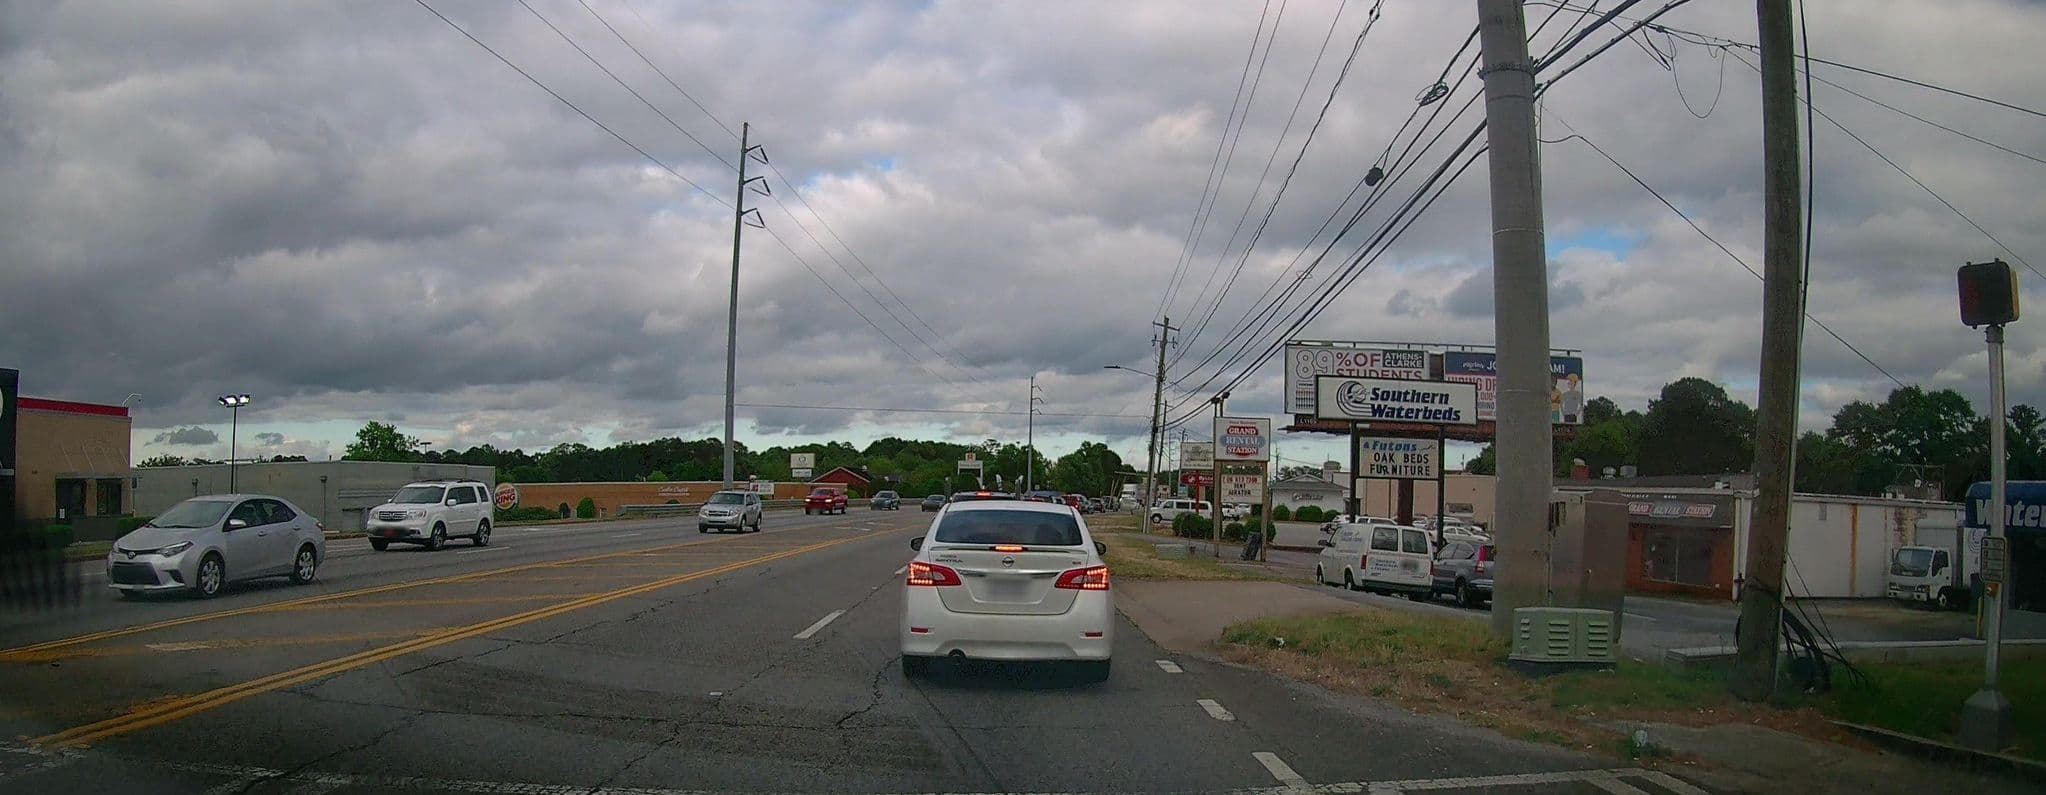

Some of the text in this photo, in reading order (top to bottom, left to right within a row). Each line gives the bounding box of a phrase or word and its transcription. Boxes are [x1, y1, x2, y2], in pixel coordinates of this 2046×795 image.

[1385, 352, 1423, 360] ATHENS-
[1385, 360, 1423, 368] CLARKE
[1369, 387, 1450, 405] Southern
[1369, 403, 1461, 422] Waterbeds
[1228, 427, 1256, 435] GRAND
[1226, 436, 1259, 445] RENTAL
[1372, 440, 1417, 452] Futons
[1227, 446, 1257, 454] STATION
[1373, 452, 1429, 464] OAK BEDS
[1369, 463, 1430, 476] FURNITURE
[495, 493, 515, 505] KING
